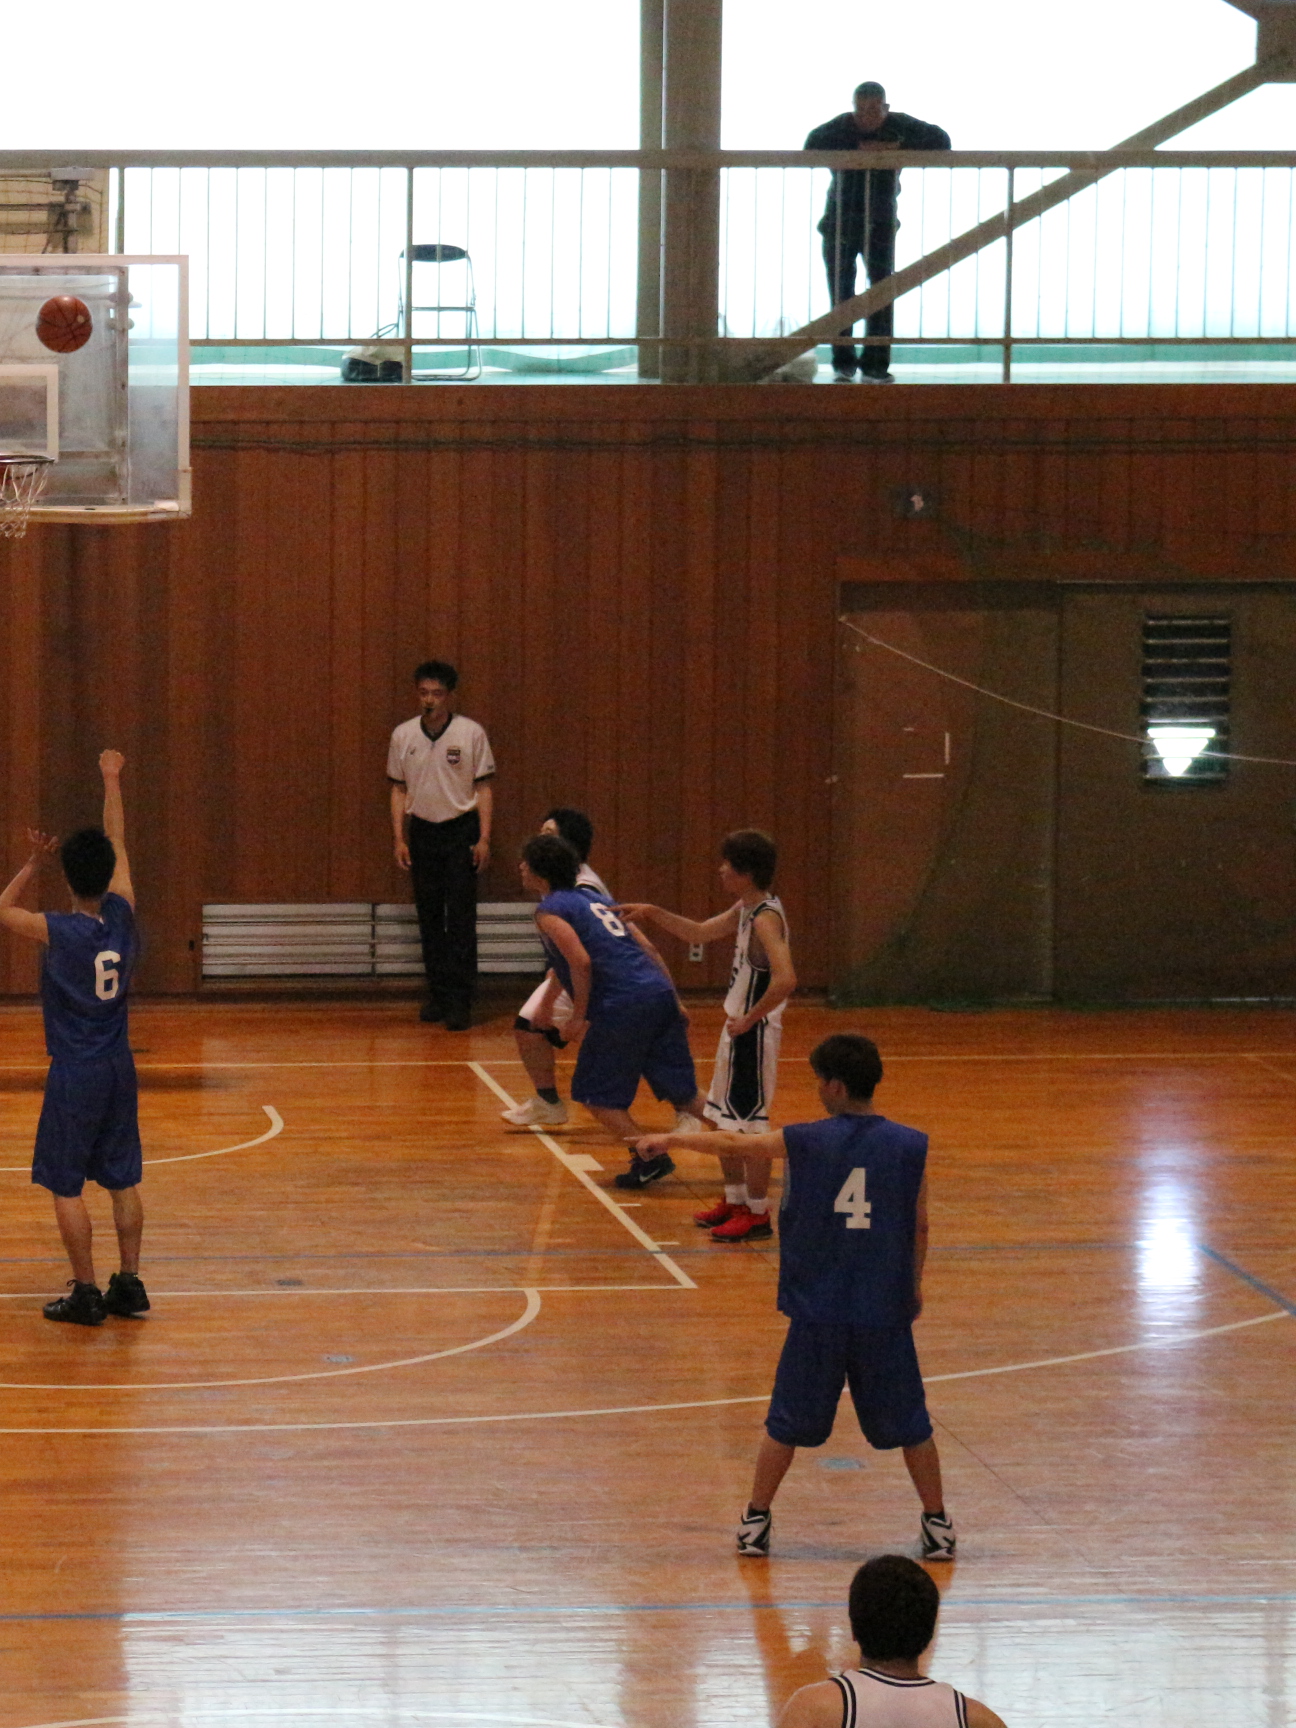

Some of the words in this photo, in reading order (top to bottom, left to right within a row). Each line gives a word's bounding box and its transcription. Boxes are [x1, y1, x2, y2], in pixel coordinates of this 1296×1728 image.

[589, 902, 625, 937] 8
[94, 950, 121, 1001] 6
[834, 1167, 872, 1229] 4
